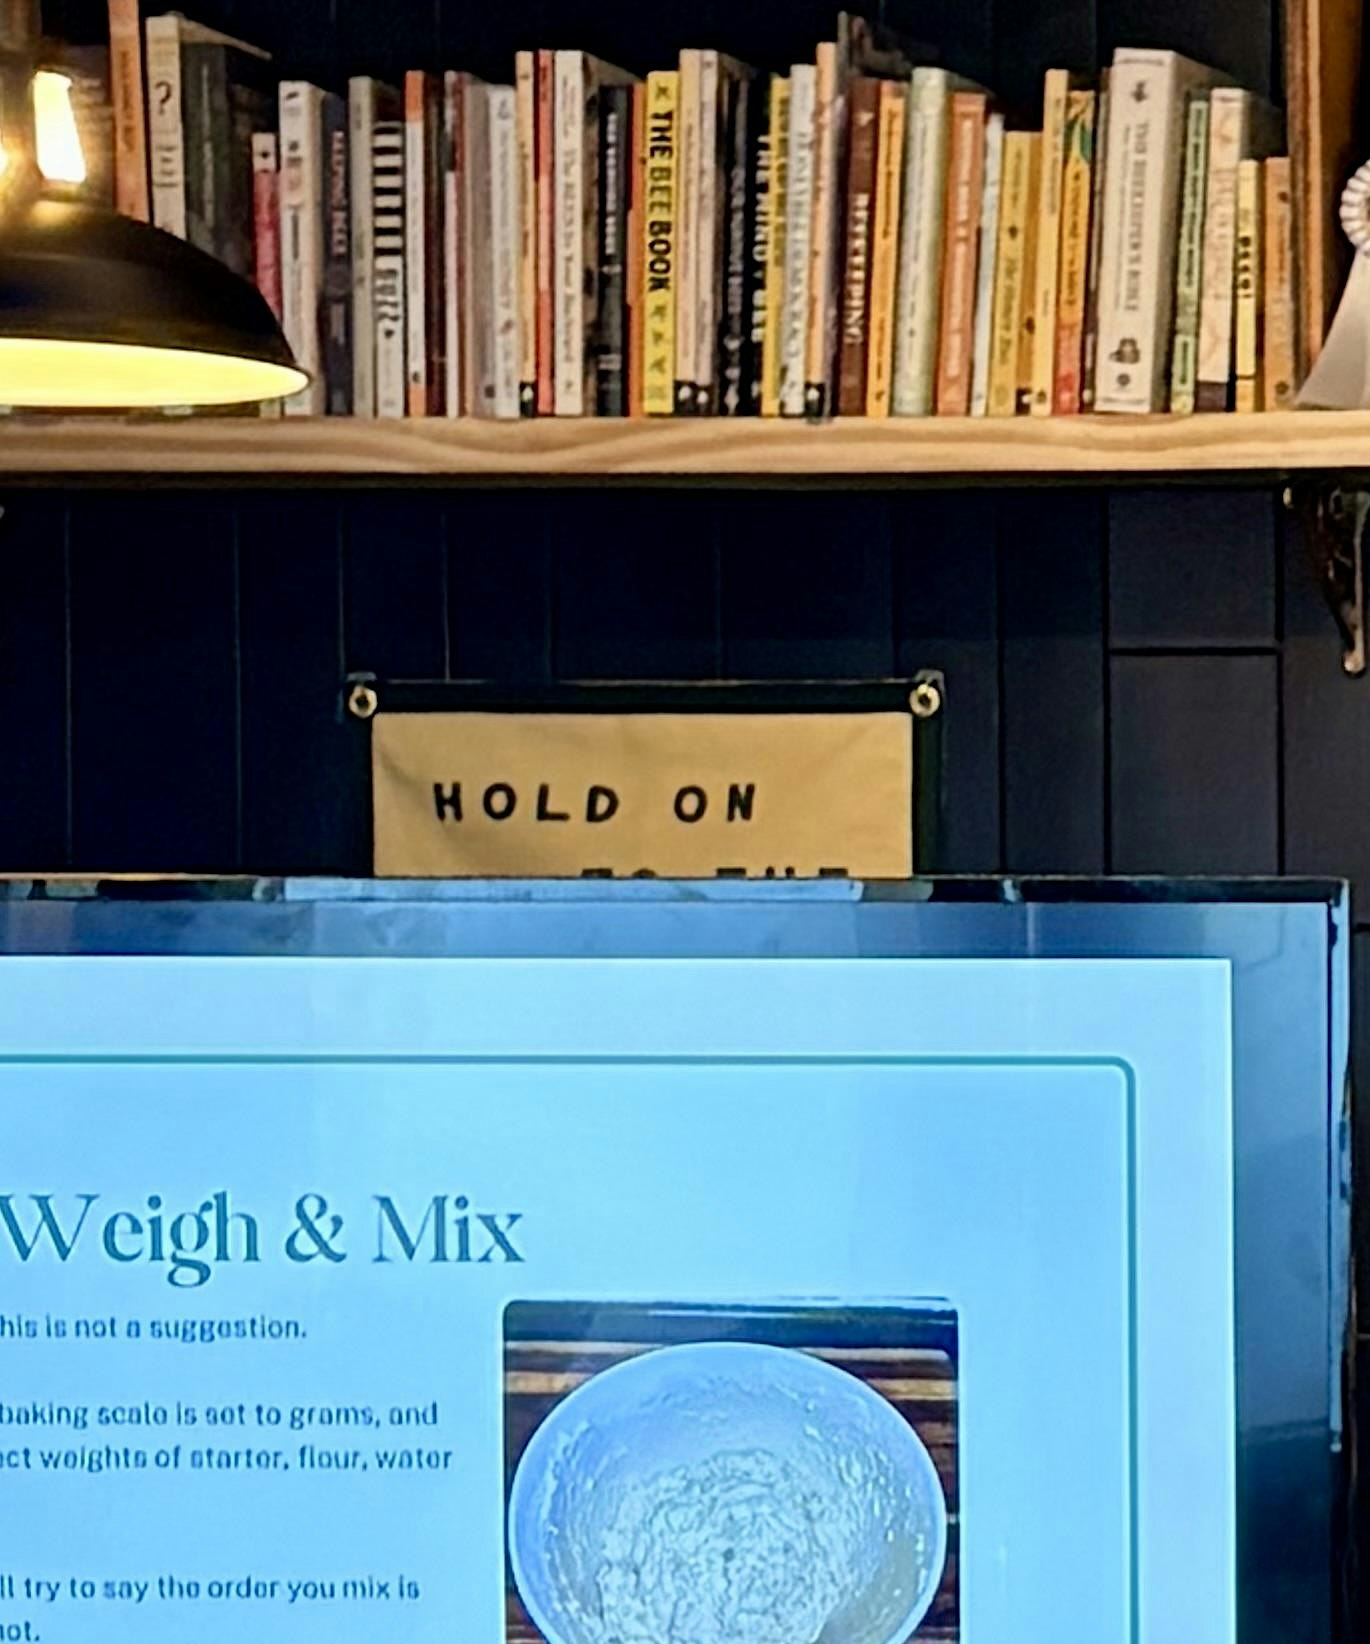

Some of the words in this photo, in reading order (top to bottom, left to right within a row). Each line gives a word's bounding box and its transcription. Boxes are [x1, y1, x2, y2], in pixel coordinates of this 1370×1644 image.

[650, 110, 673, 158] THE
[649, 165, 672, 213] BEE
[648, 220, 672, 293] BOOK
[843, 192, 871, 346] BEEKEEPING
[374, 267, 400, 323] BUZZ
[434, 783, 619, 822] HOLD
[674, 783, 756, 822] ON
[0, 1190, 261, 1288] Weigh
[285, 1193, 347, 1263] &
[372, 1193, 525, 1264] Mix
[46, 1314, 67, 1338] is
[75, 1317, 117, 1338] not
[126, 1320, 141, 1338] a
[150, 1314, 307, 1343] suggestion.
[98, 1401, 167, 1426] scale
[176, 1401, 197, 1426] is
[205, 1403, 245, 1426] set
[256, 1404, 281, 1426] to
[289, 1406, 381, 1430] grams,
[389, 1400, 438, 1426] and
[39, 1444, 147, 1473] weights
[154, 1445, 181, 1469] of
[190, 1448, 289, 1471] starter,
[299, 1445, 368, 1472] flour,
[375, 1448, 453, 1470] water
[24, 1577, 61, 1603] try
[70, 1577, 95, 1599] to
[103, 1581, 149, 1604] say
[158, 1574, 200, 1600] the
[207, 1575, 280, 1599] order
[287, 1581, 335, 1604] you
[343, 1576, 390, 1600] mix
[399, 1574, 420, 1600] is
